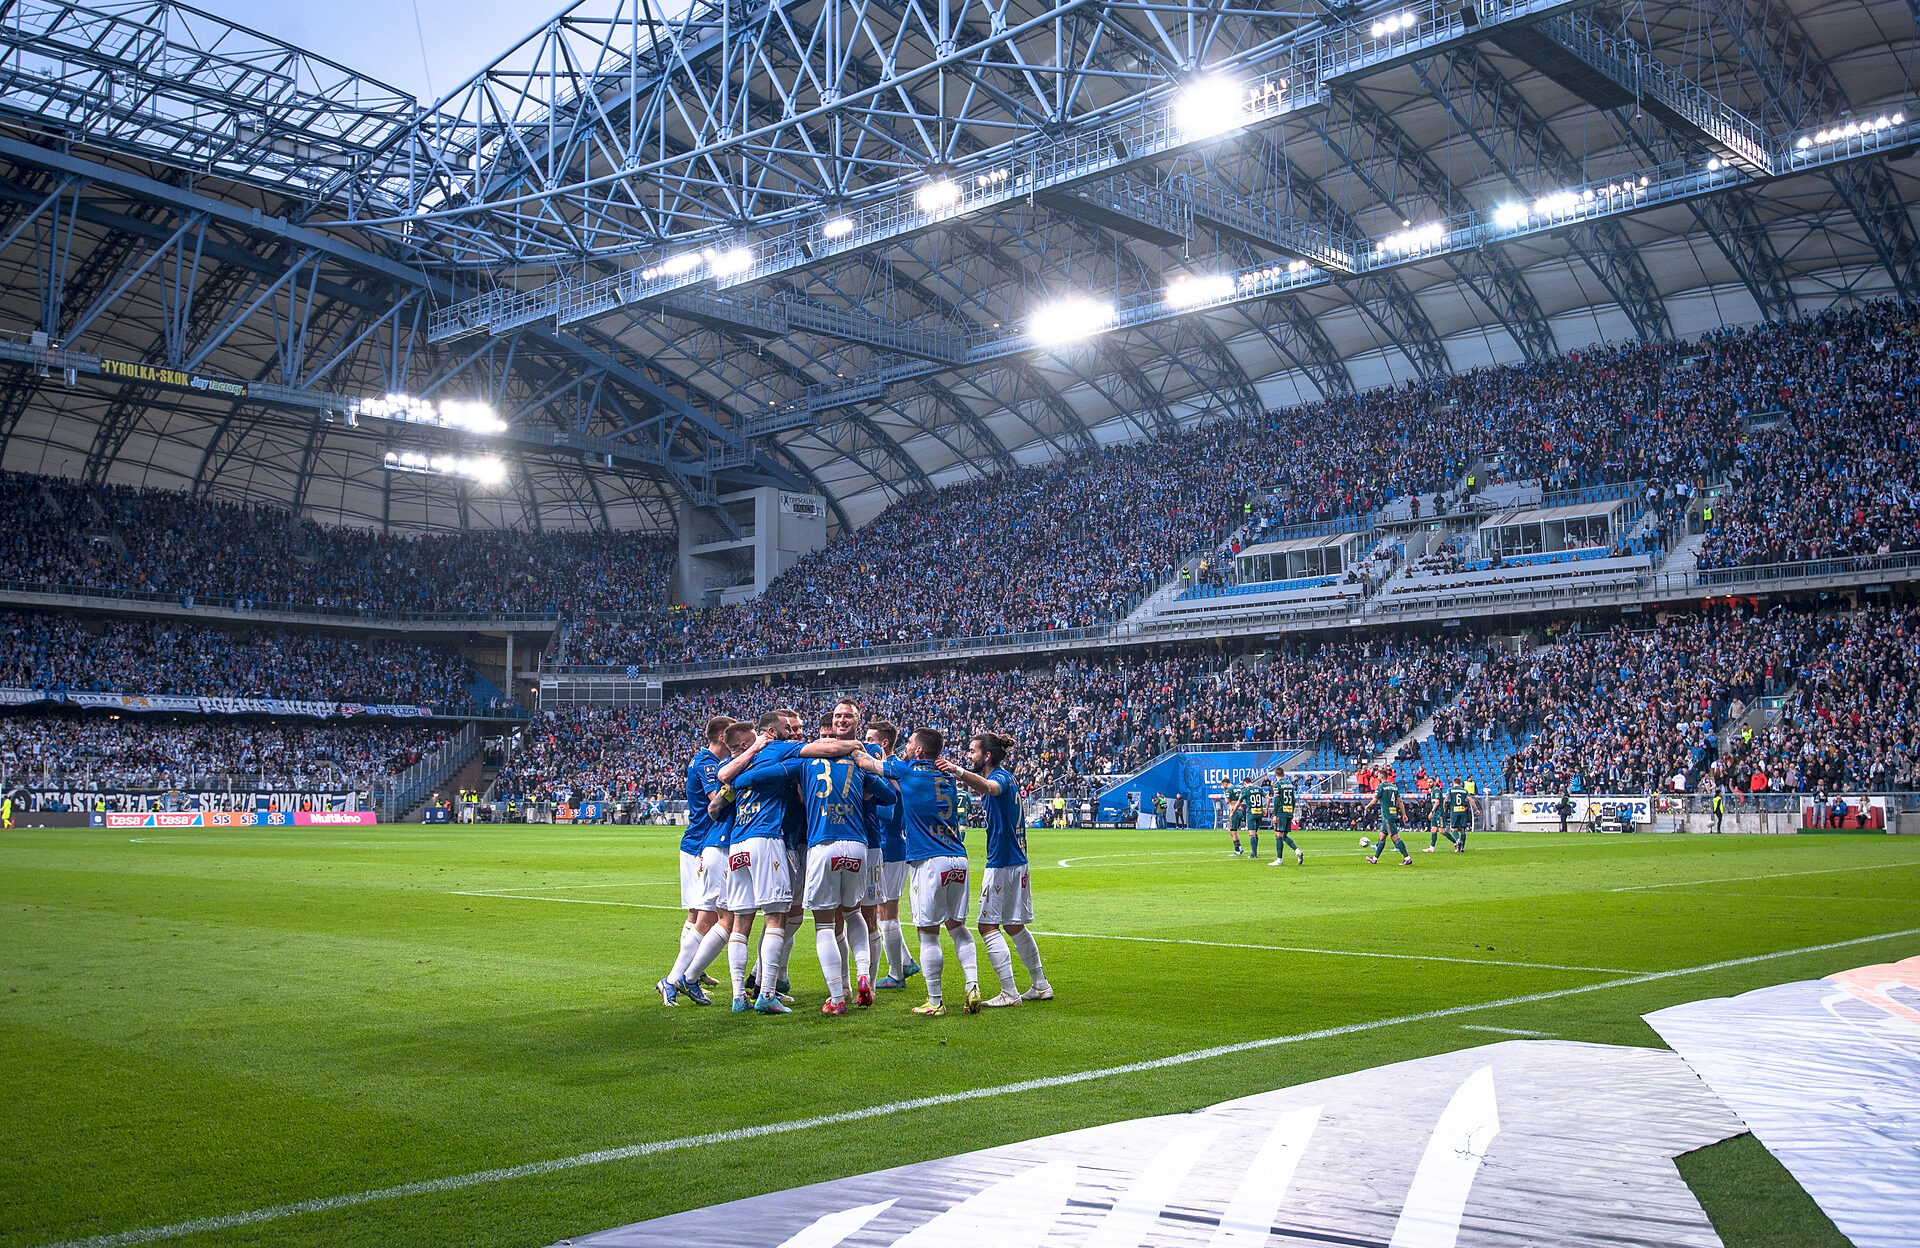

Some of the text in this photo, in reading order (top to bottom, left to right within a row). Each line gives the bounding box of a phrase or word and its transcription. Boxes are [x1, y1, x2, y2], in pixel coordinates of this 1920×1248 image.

[811, 758, 854, 798] 37
[1204, 768, 1229, 784] LECH
[934, 776, 953, 820] 5
[1250, 794, 1262, 807] 99
[1283, 789, 1293, 804] 55
[1390, 791, 1396, 806] 4
[1455, 793, 1462, 806] 6
[586, 805, 597, 817] STS
[821, 803, 854, 816] LECH
[1520, 801, 1577, 816] OSKR
[110, 815, 141, 825] tesa
[159, 815, 189, 825] tesa
[213, 813, 230, 825] STS
[241, 813, 258, 825] STS
[268, 813, 285, 825] STS
[310, 813, 361, 824] Multikino
